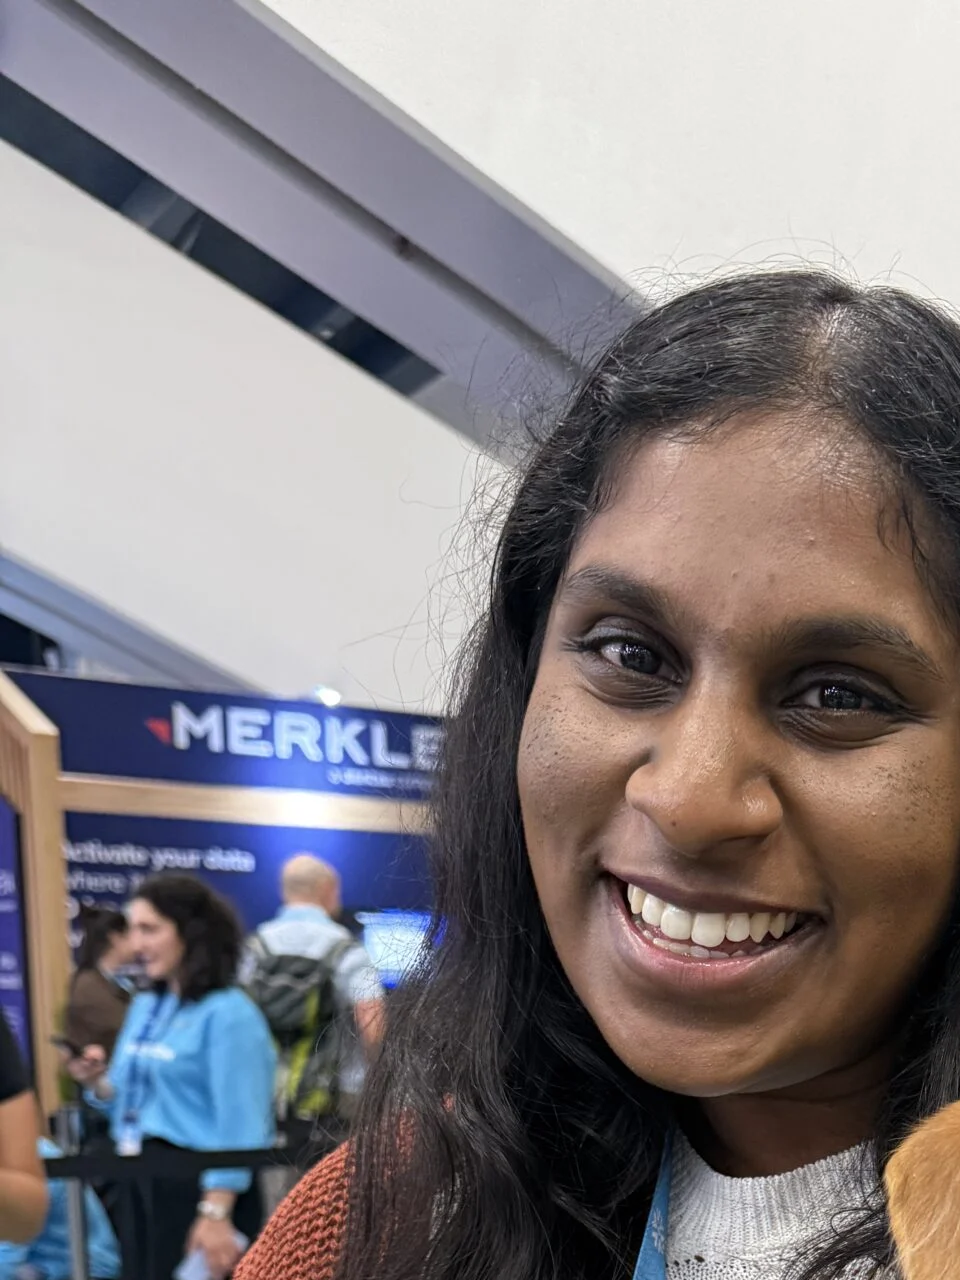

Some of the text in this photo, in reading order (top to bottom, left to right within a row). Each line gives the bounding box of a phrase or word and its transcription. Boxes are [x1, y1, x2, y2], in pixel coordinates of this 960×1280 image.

[171, 700, 447, 771] MERKLE
[151, 848, 200, 872] your
[203, 845, 256, 872] data
